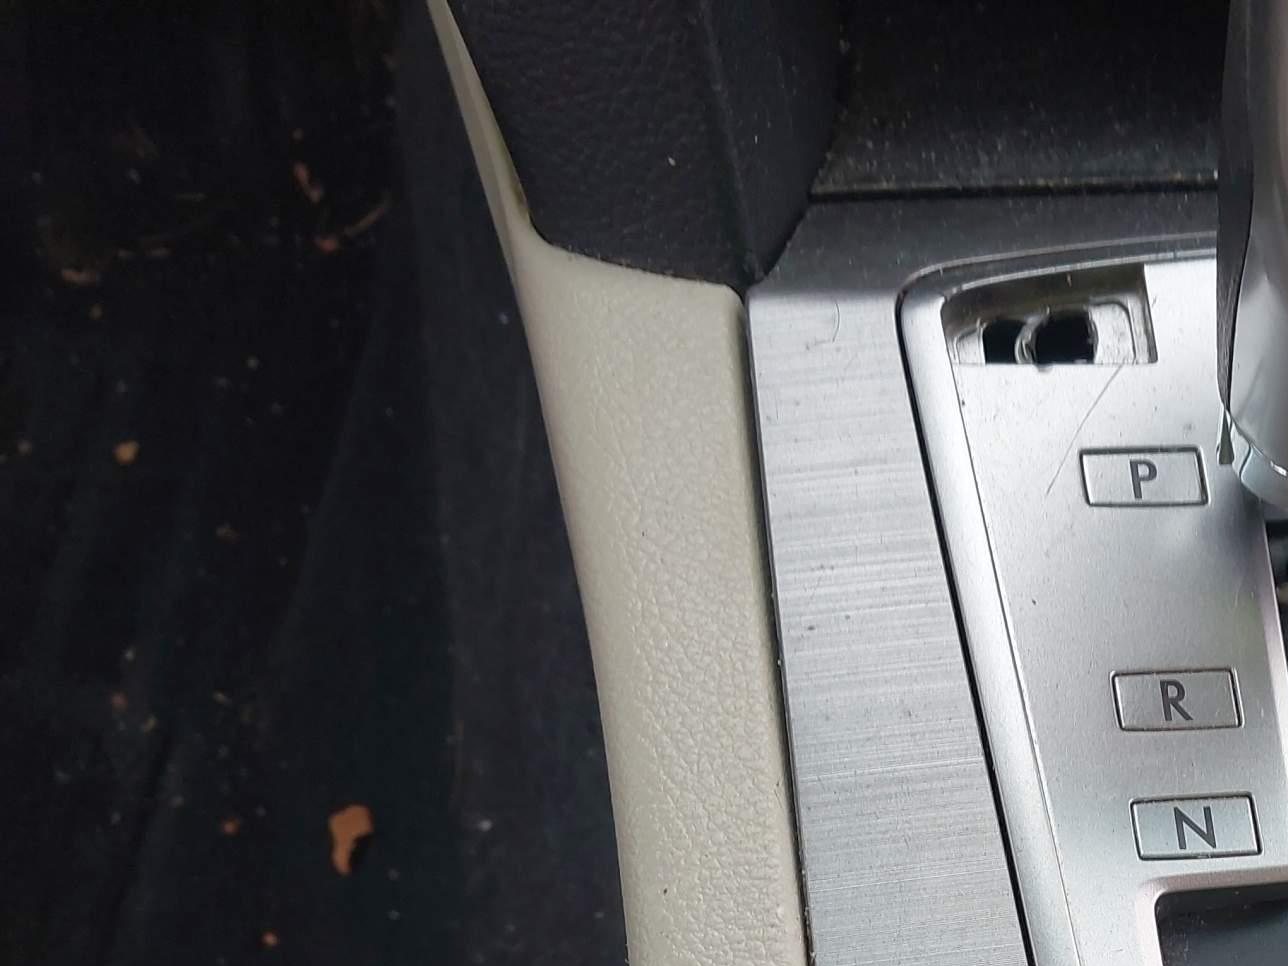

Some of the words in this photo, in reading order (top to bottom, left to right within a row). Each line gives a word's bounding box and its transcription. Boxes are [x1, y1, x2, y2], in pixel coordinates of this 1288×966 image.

[1130, 459, 1157, 499] P
[1160, 680, 1193, 721] R
[1174, 806, 1217, 850] N
